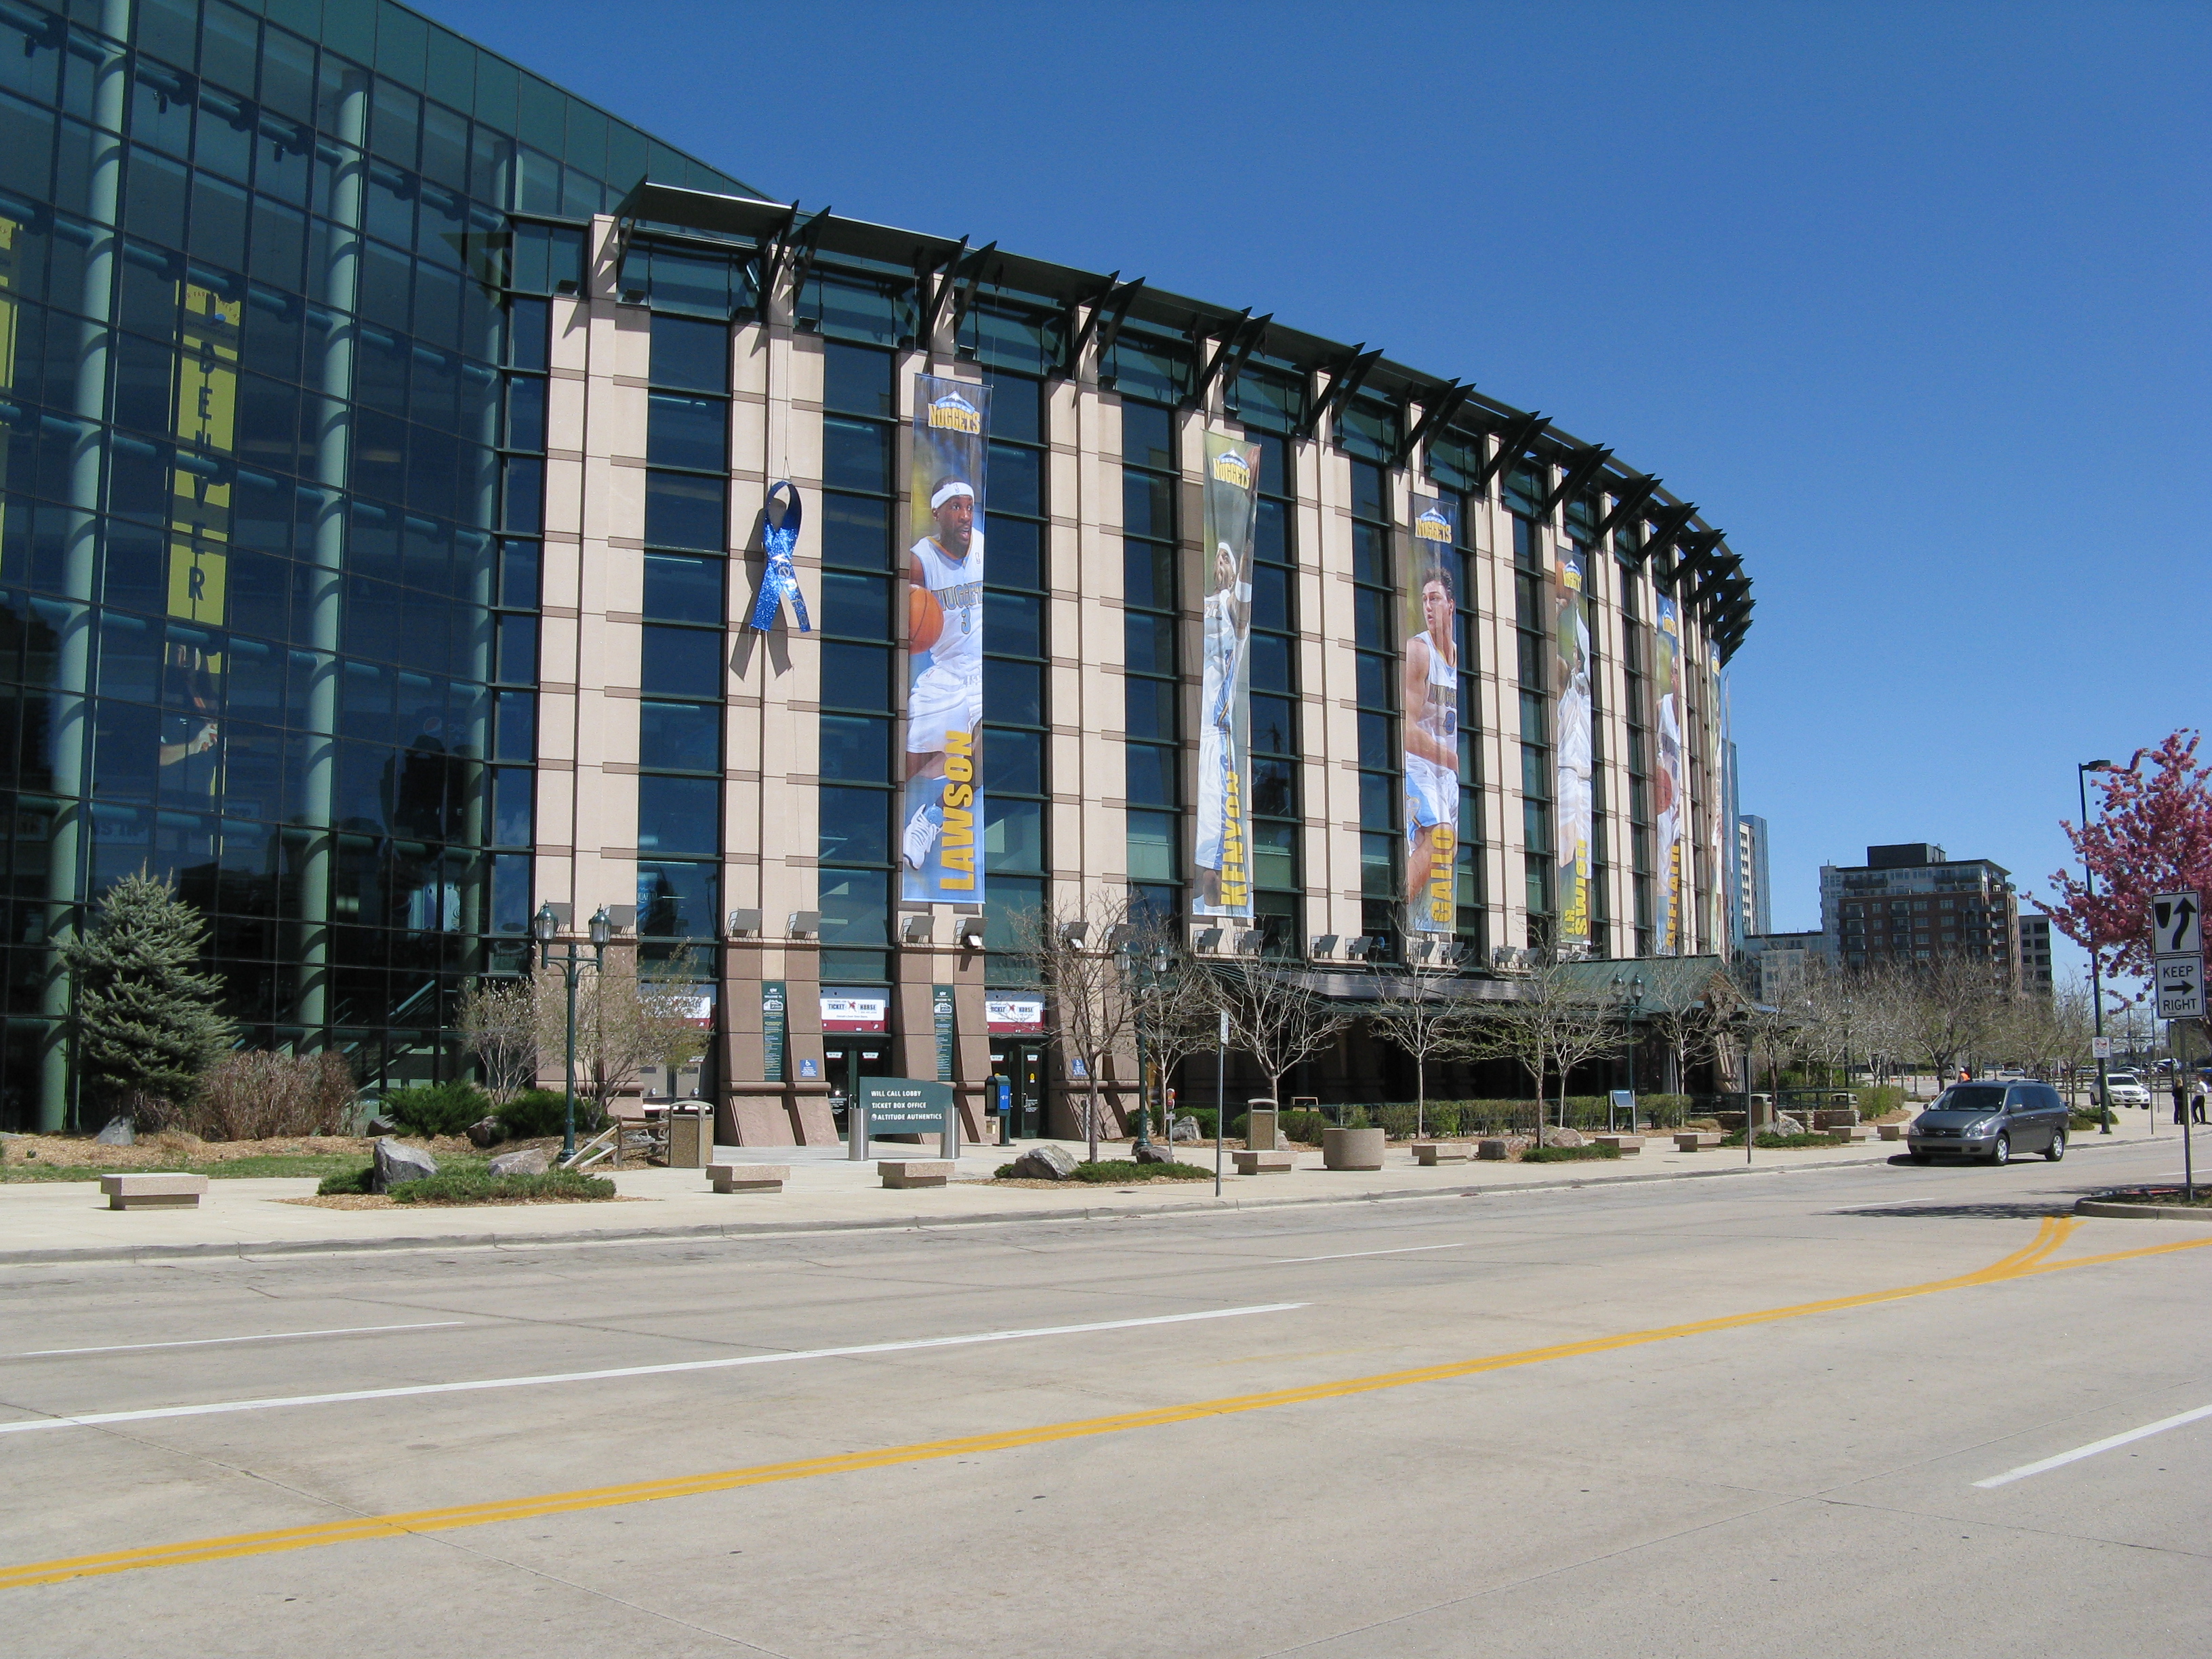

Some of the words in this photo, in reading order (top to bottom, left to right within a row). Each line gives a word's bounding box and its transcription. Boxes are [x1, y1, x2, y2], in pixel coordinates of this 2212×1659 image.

[928, 403, 981, 434] NUGGETS
[188, 341, 216, 601] DENVER
[1212, 457, 1250, 490] NUGGETS
[1415, 517, 1452, 544] NUGGETS
[961, 608, 971, 634] 3
[1444, 710, 1456, 734] 8
[940, 730, 975, 890] LAWSON
[1220, 770, 1248, 907] KENYON
[1430, 828, 1454, 922] GALLO
[1574, 839, 1588, 936] SWISH
[2163, 966, 2194, 978] KEEP
[2163, 998, 2196, 1011] RIGHT
